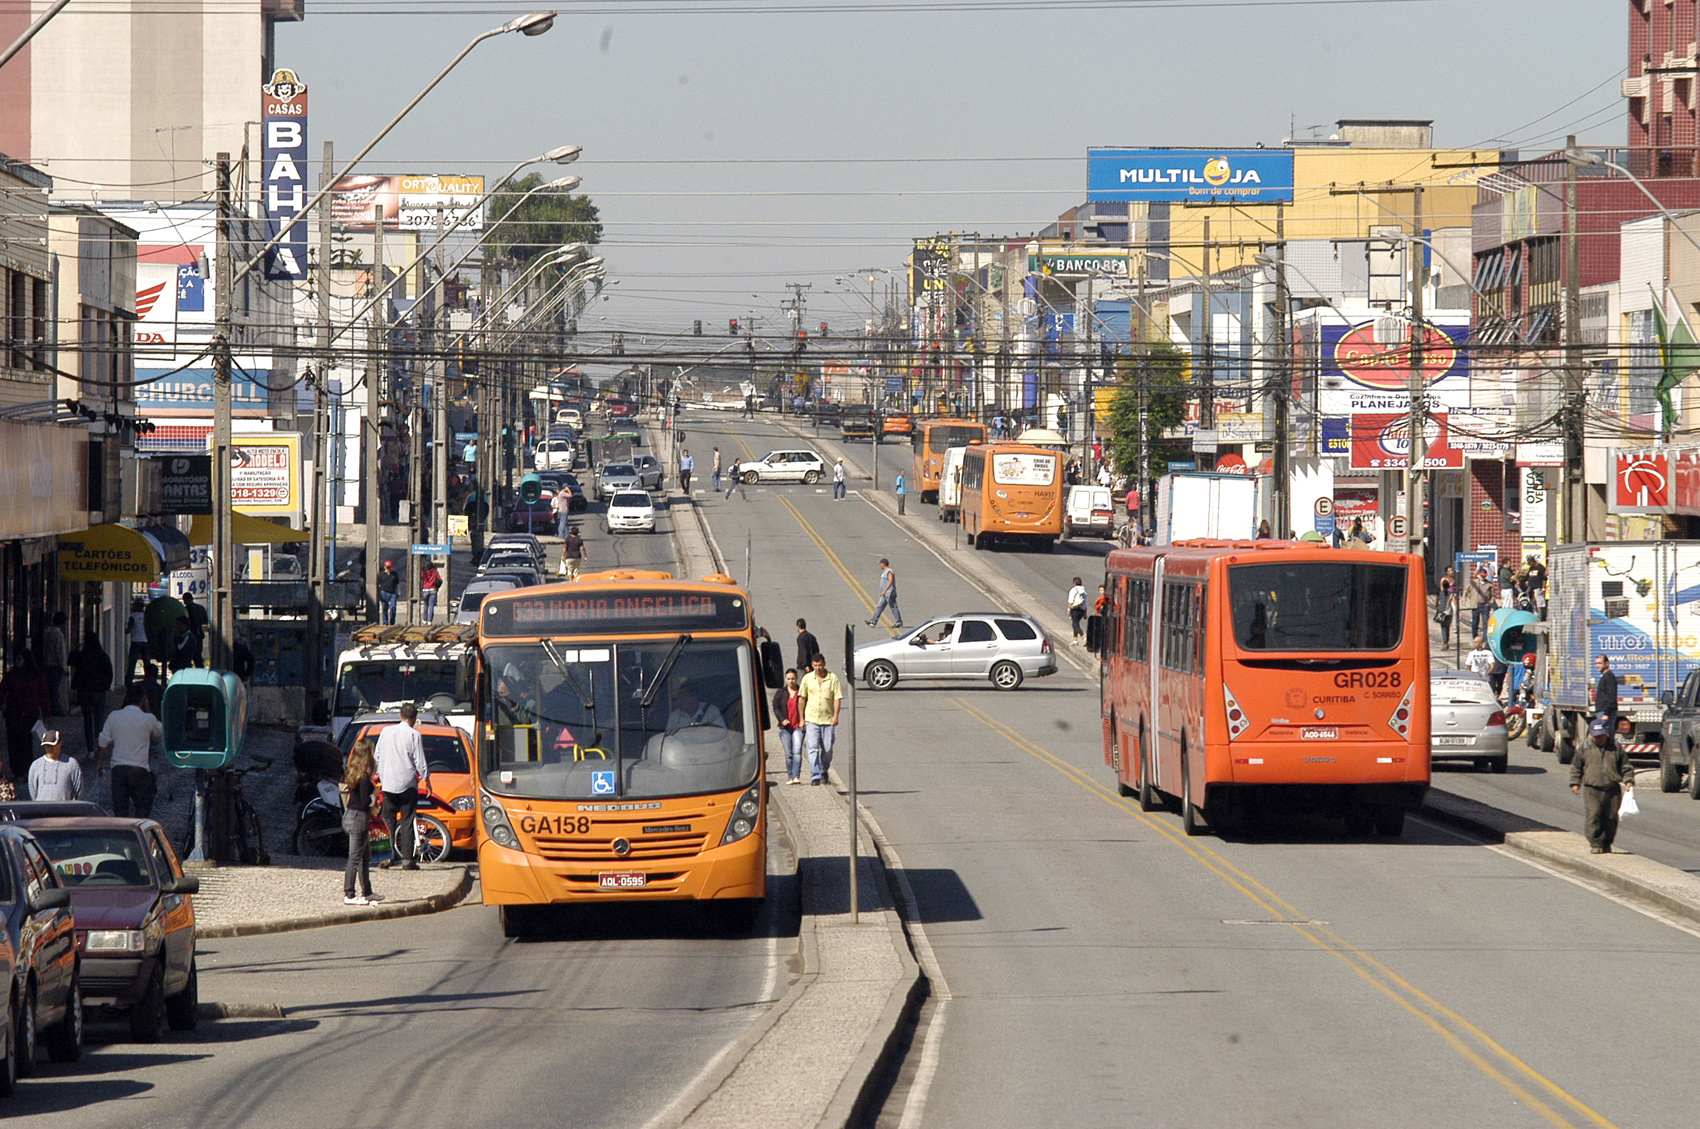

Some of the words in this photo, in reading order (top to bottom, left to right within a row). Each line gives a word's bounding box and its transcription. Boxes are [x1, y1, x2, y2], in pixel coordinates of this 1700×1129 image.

[268, 103, 303, 115] CASAS
[1211, 186, 1221, 195] de
[1224, 187, 1261, 197] comprar
[267, 121, 304, 275] BAHIA
[1057, 259, 1100, 271] BANCO
[136, 332, 166, 343] DA
[135, 382, 262, 403] CHURCILL
[1352, 400, 1440, 409] PLANEJAOS
[247, 454, 287, 468] MODELO
[162, 484, 208, 496] ANTAS
[231, 488, 276, 498] 018-1329
[1319, 500, 1329, 513] E
[1393, 519, 1404, 533] E
[74, 547, 132, 560] CARTÕES
[63, 560, 148, 572] TELEFÔNICOS
[549, 599, 608, 620] MARIA
[614, 595, 712, 618] ANGELICA
[1598, 634, 1647, 650] TITOS
[1334, 671, 1402, 688] GR028
[1312, 695, 1356, 704] CURITIBA
[1372, 691, 1402, 699] SORRISO
[577, 801, 662, 812] NEOBUS
[521, 815, 590, 834] GA158
[644, 824, 690, 834] Mercedes-Benz
